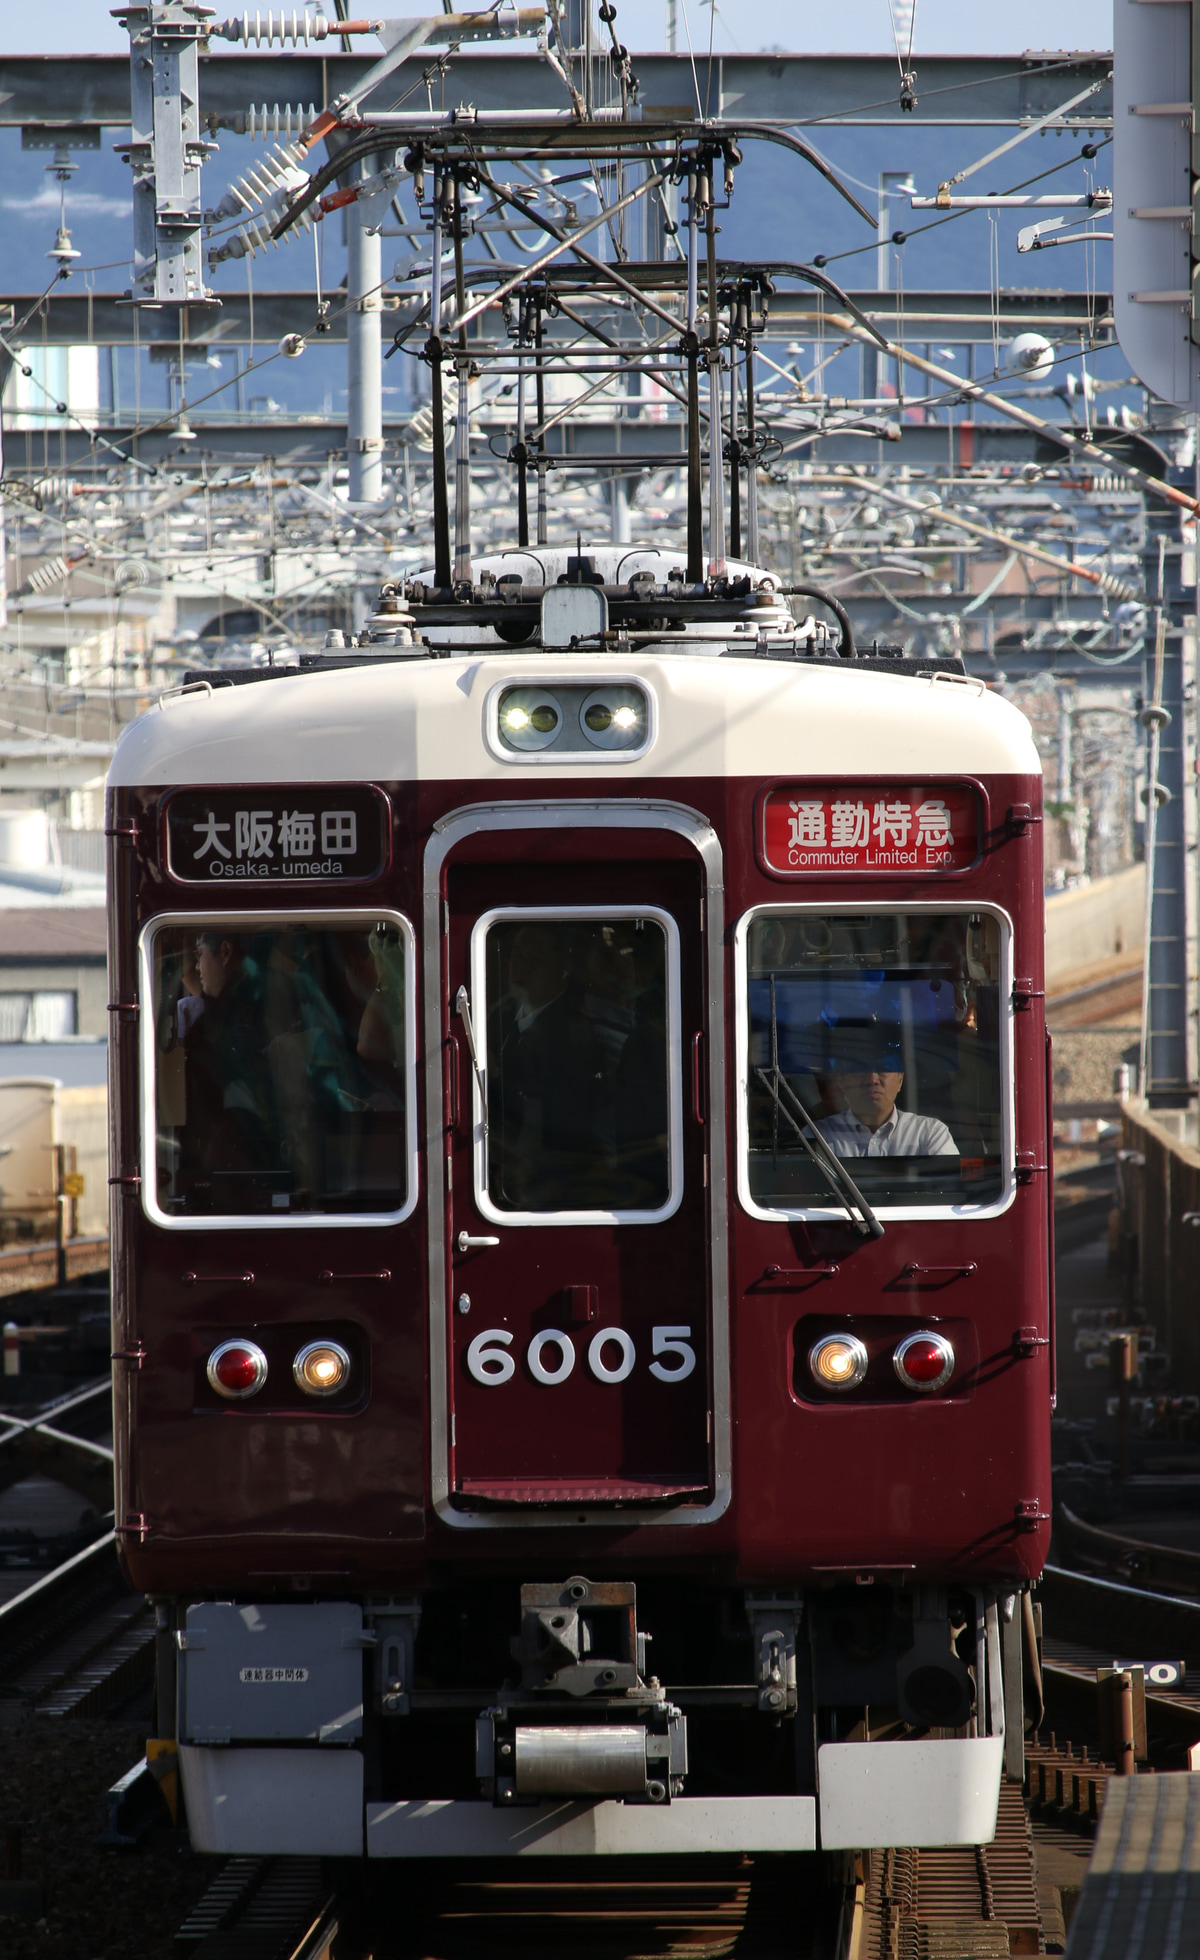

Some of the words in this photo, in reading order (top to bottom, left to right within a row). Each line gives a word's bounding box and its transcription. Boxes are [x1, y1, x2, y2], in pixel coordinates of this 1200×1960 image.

[193, 810, 357, 860] 大阪梅田
[787, 799, 955, 848] 通勤特急
[209, 859, 344, 876] Osaka-umeda
[788, 849, 859, 865] Commuter
[866, 848, 918, 864] Limited
[925, 848, 955, 865] Exp.
[467, 1326, 697, 1386] 6005
